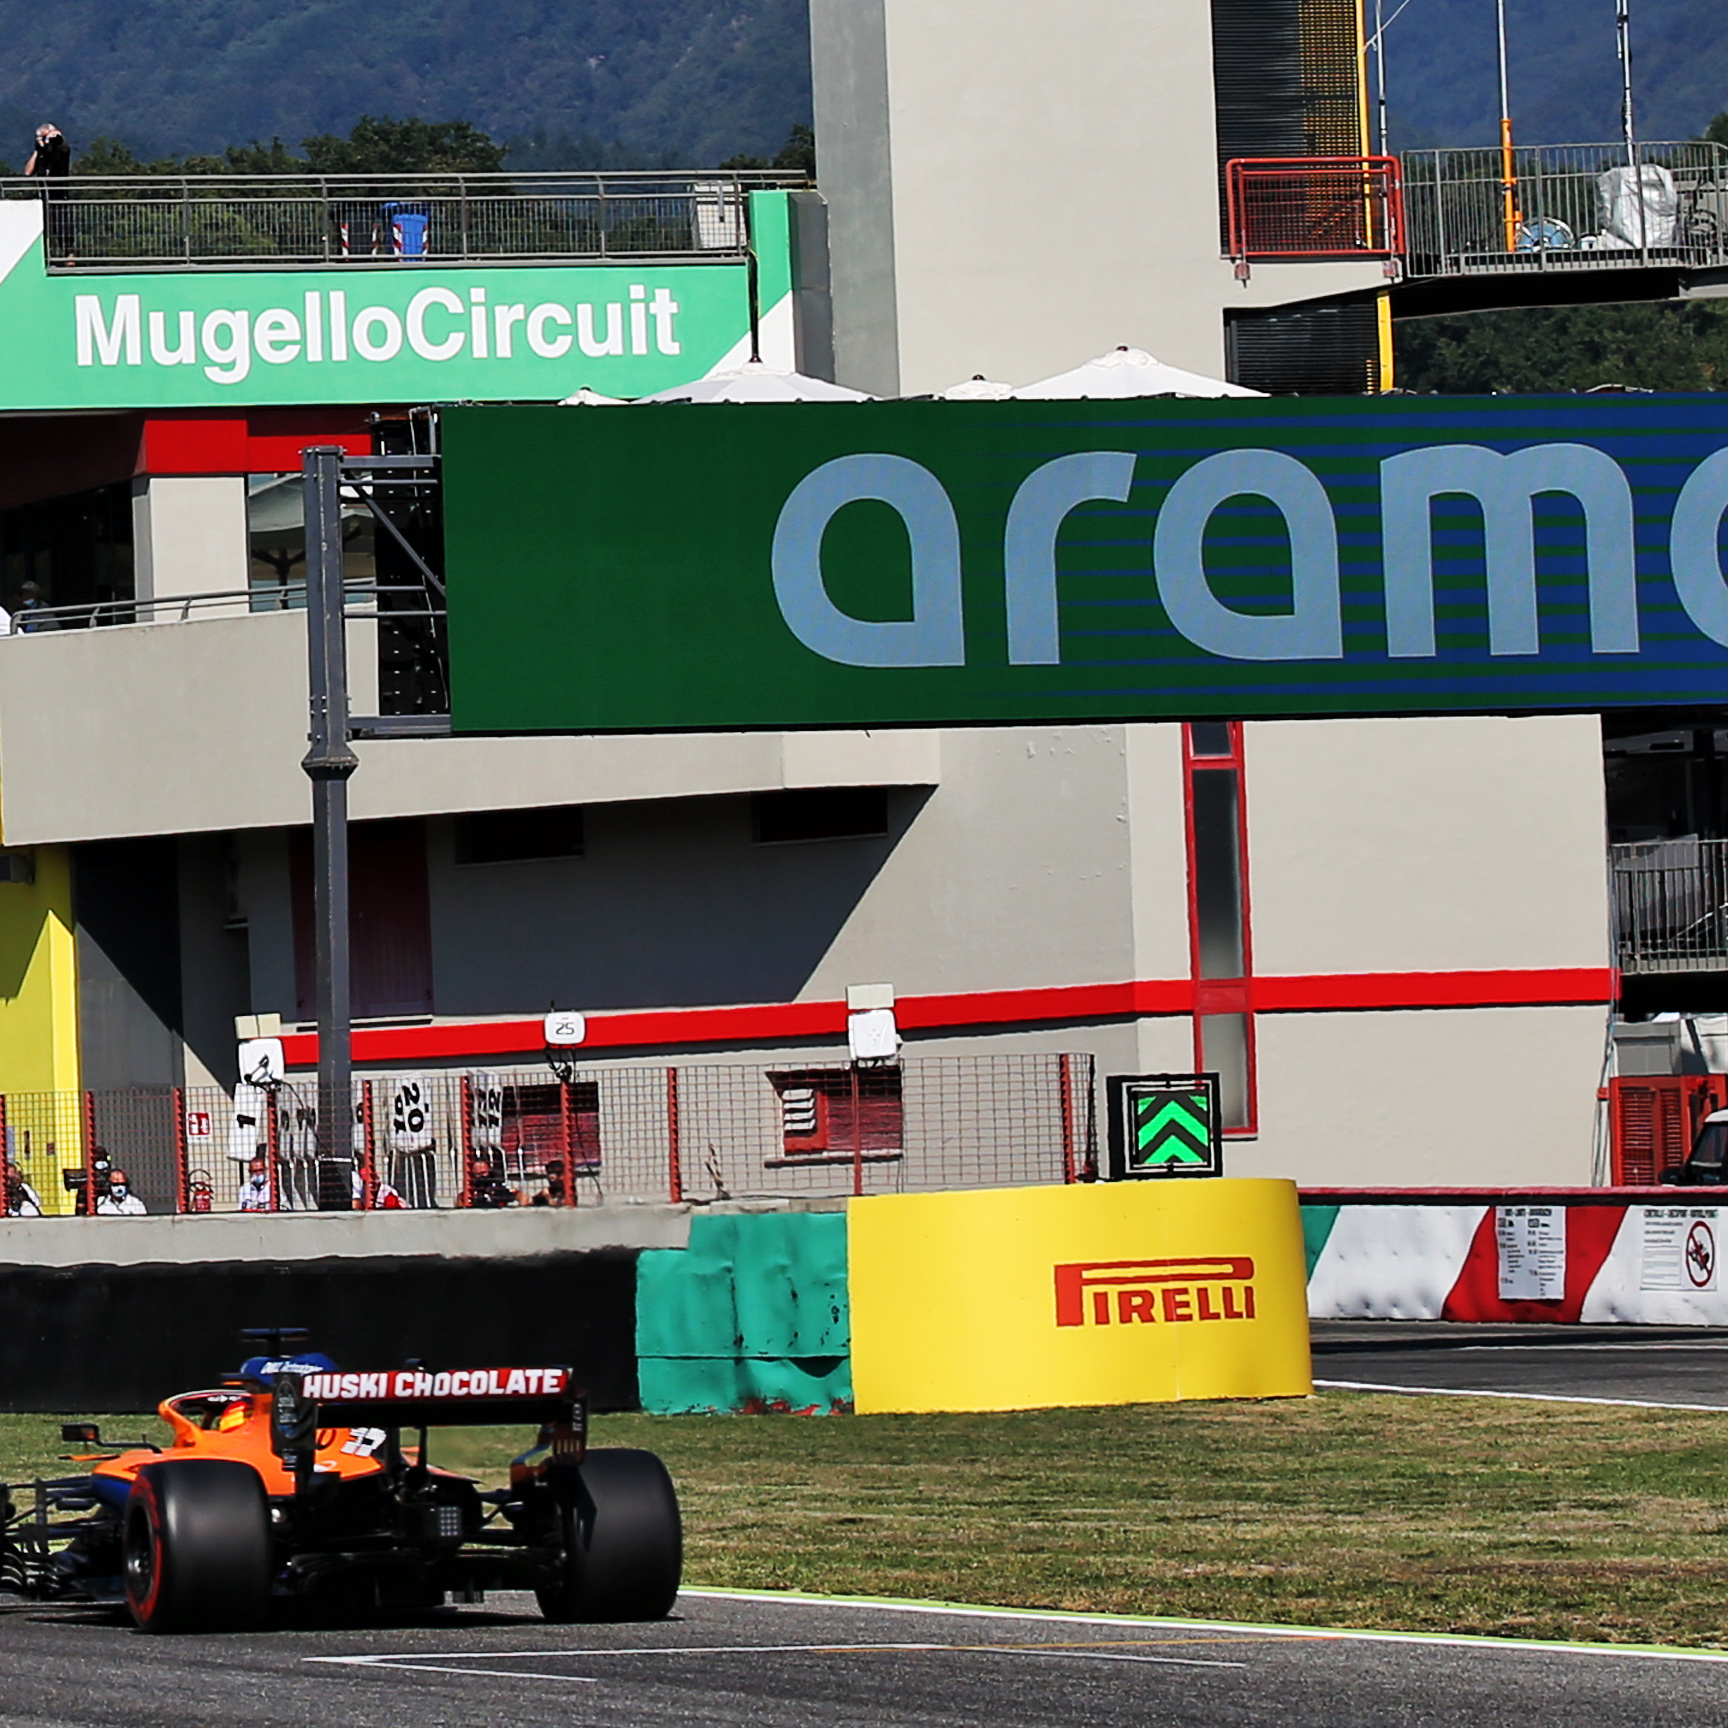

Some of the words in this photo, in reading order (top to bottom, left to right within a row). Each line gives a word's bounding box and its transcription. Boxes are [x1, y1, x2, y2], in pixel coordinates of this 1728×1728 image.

[75, 285, 680, 384] MugelloCircuit
[555, 1022, 575, 1035] 25
[1054, 1256, 1256, 1327] PIRELLI
[302, 1373, 388, 1399] HUSKI
[394, 1369, 563, 1398] CHOCOLATE
